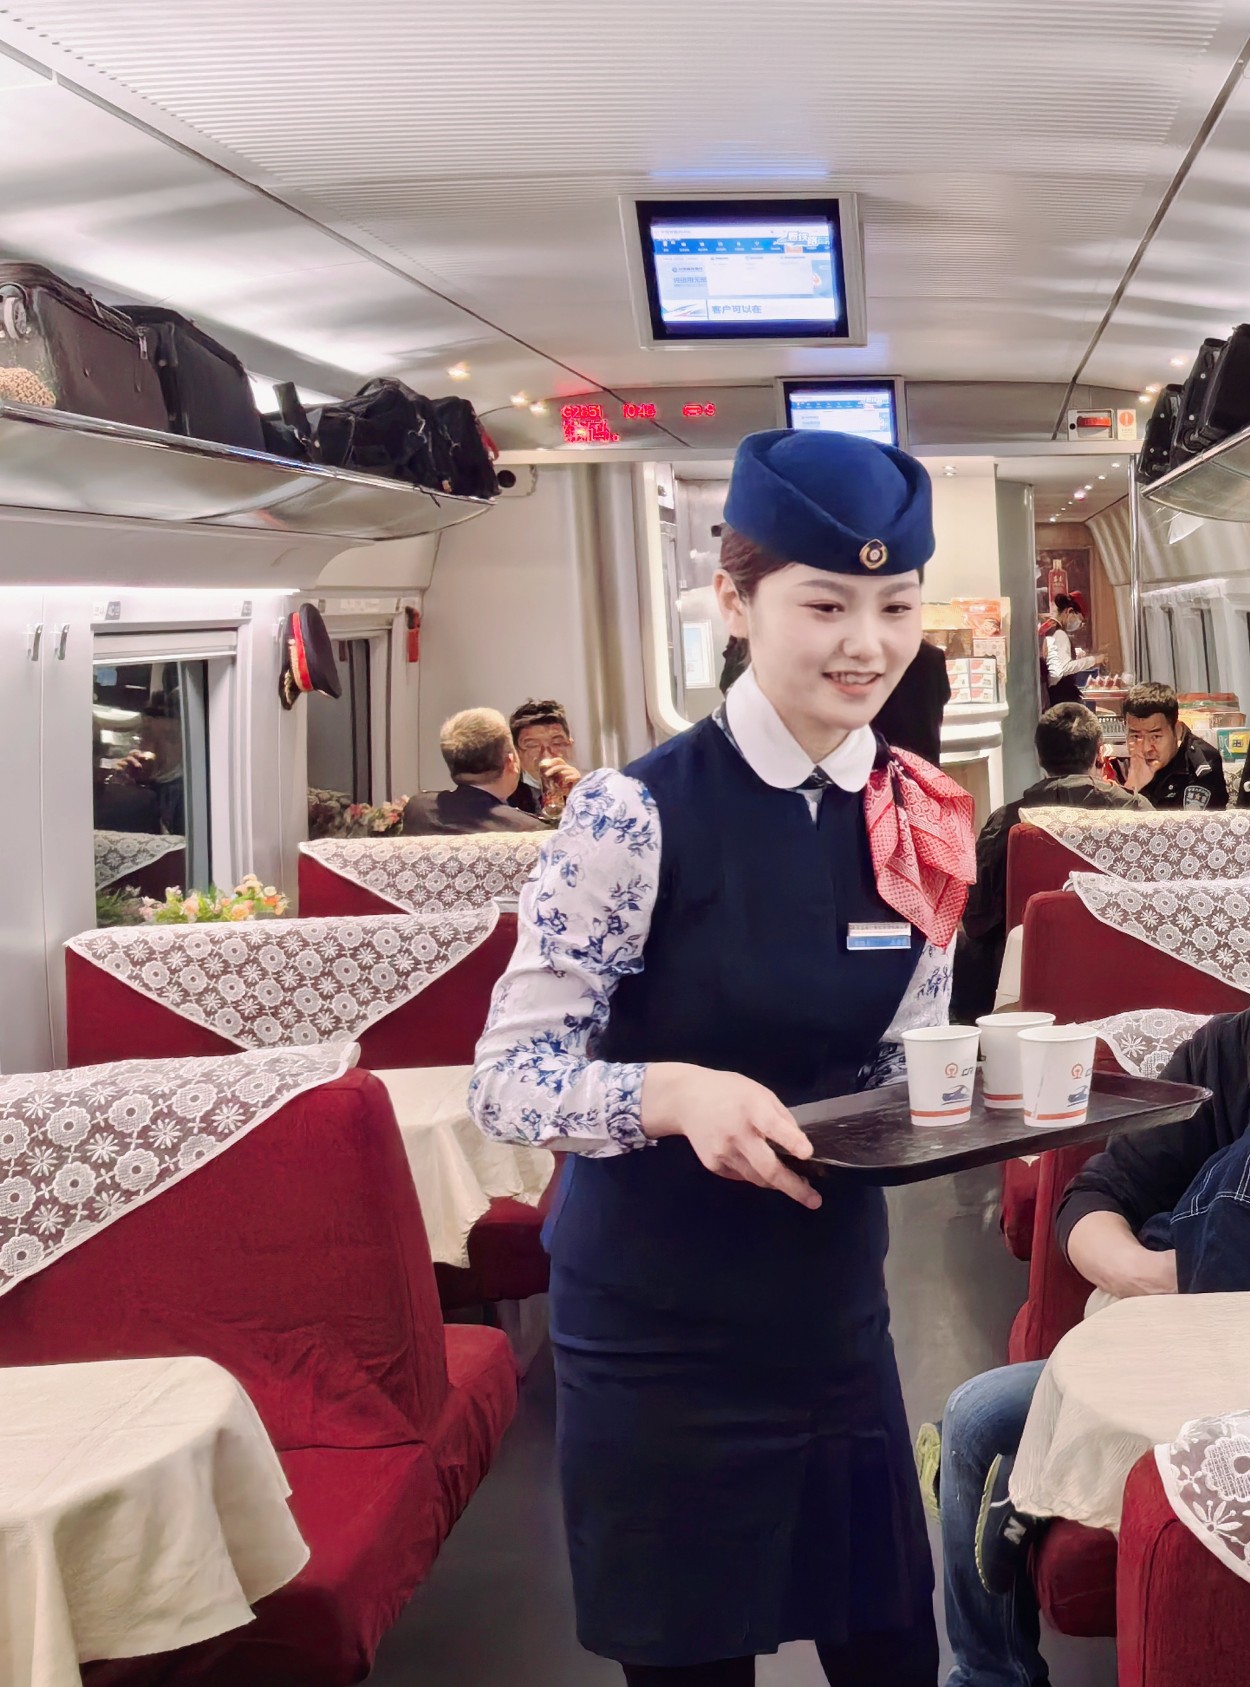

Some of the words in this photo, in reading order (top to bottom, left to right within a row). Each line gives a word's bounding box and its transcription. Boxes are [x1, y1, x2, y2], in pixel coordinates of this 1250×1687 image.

[712, 304, 762, 314] 客户可以在
